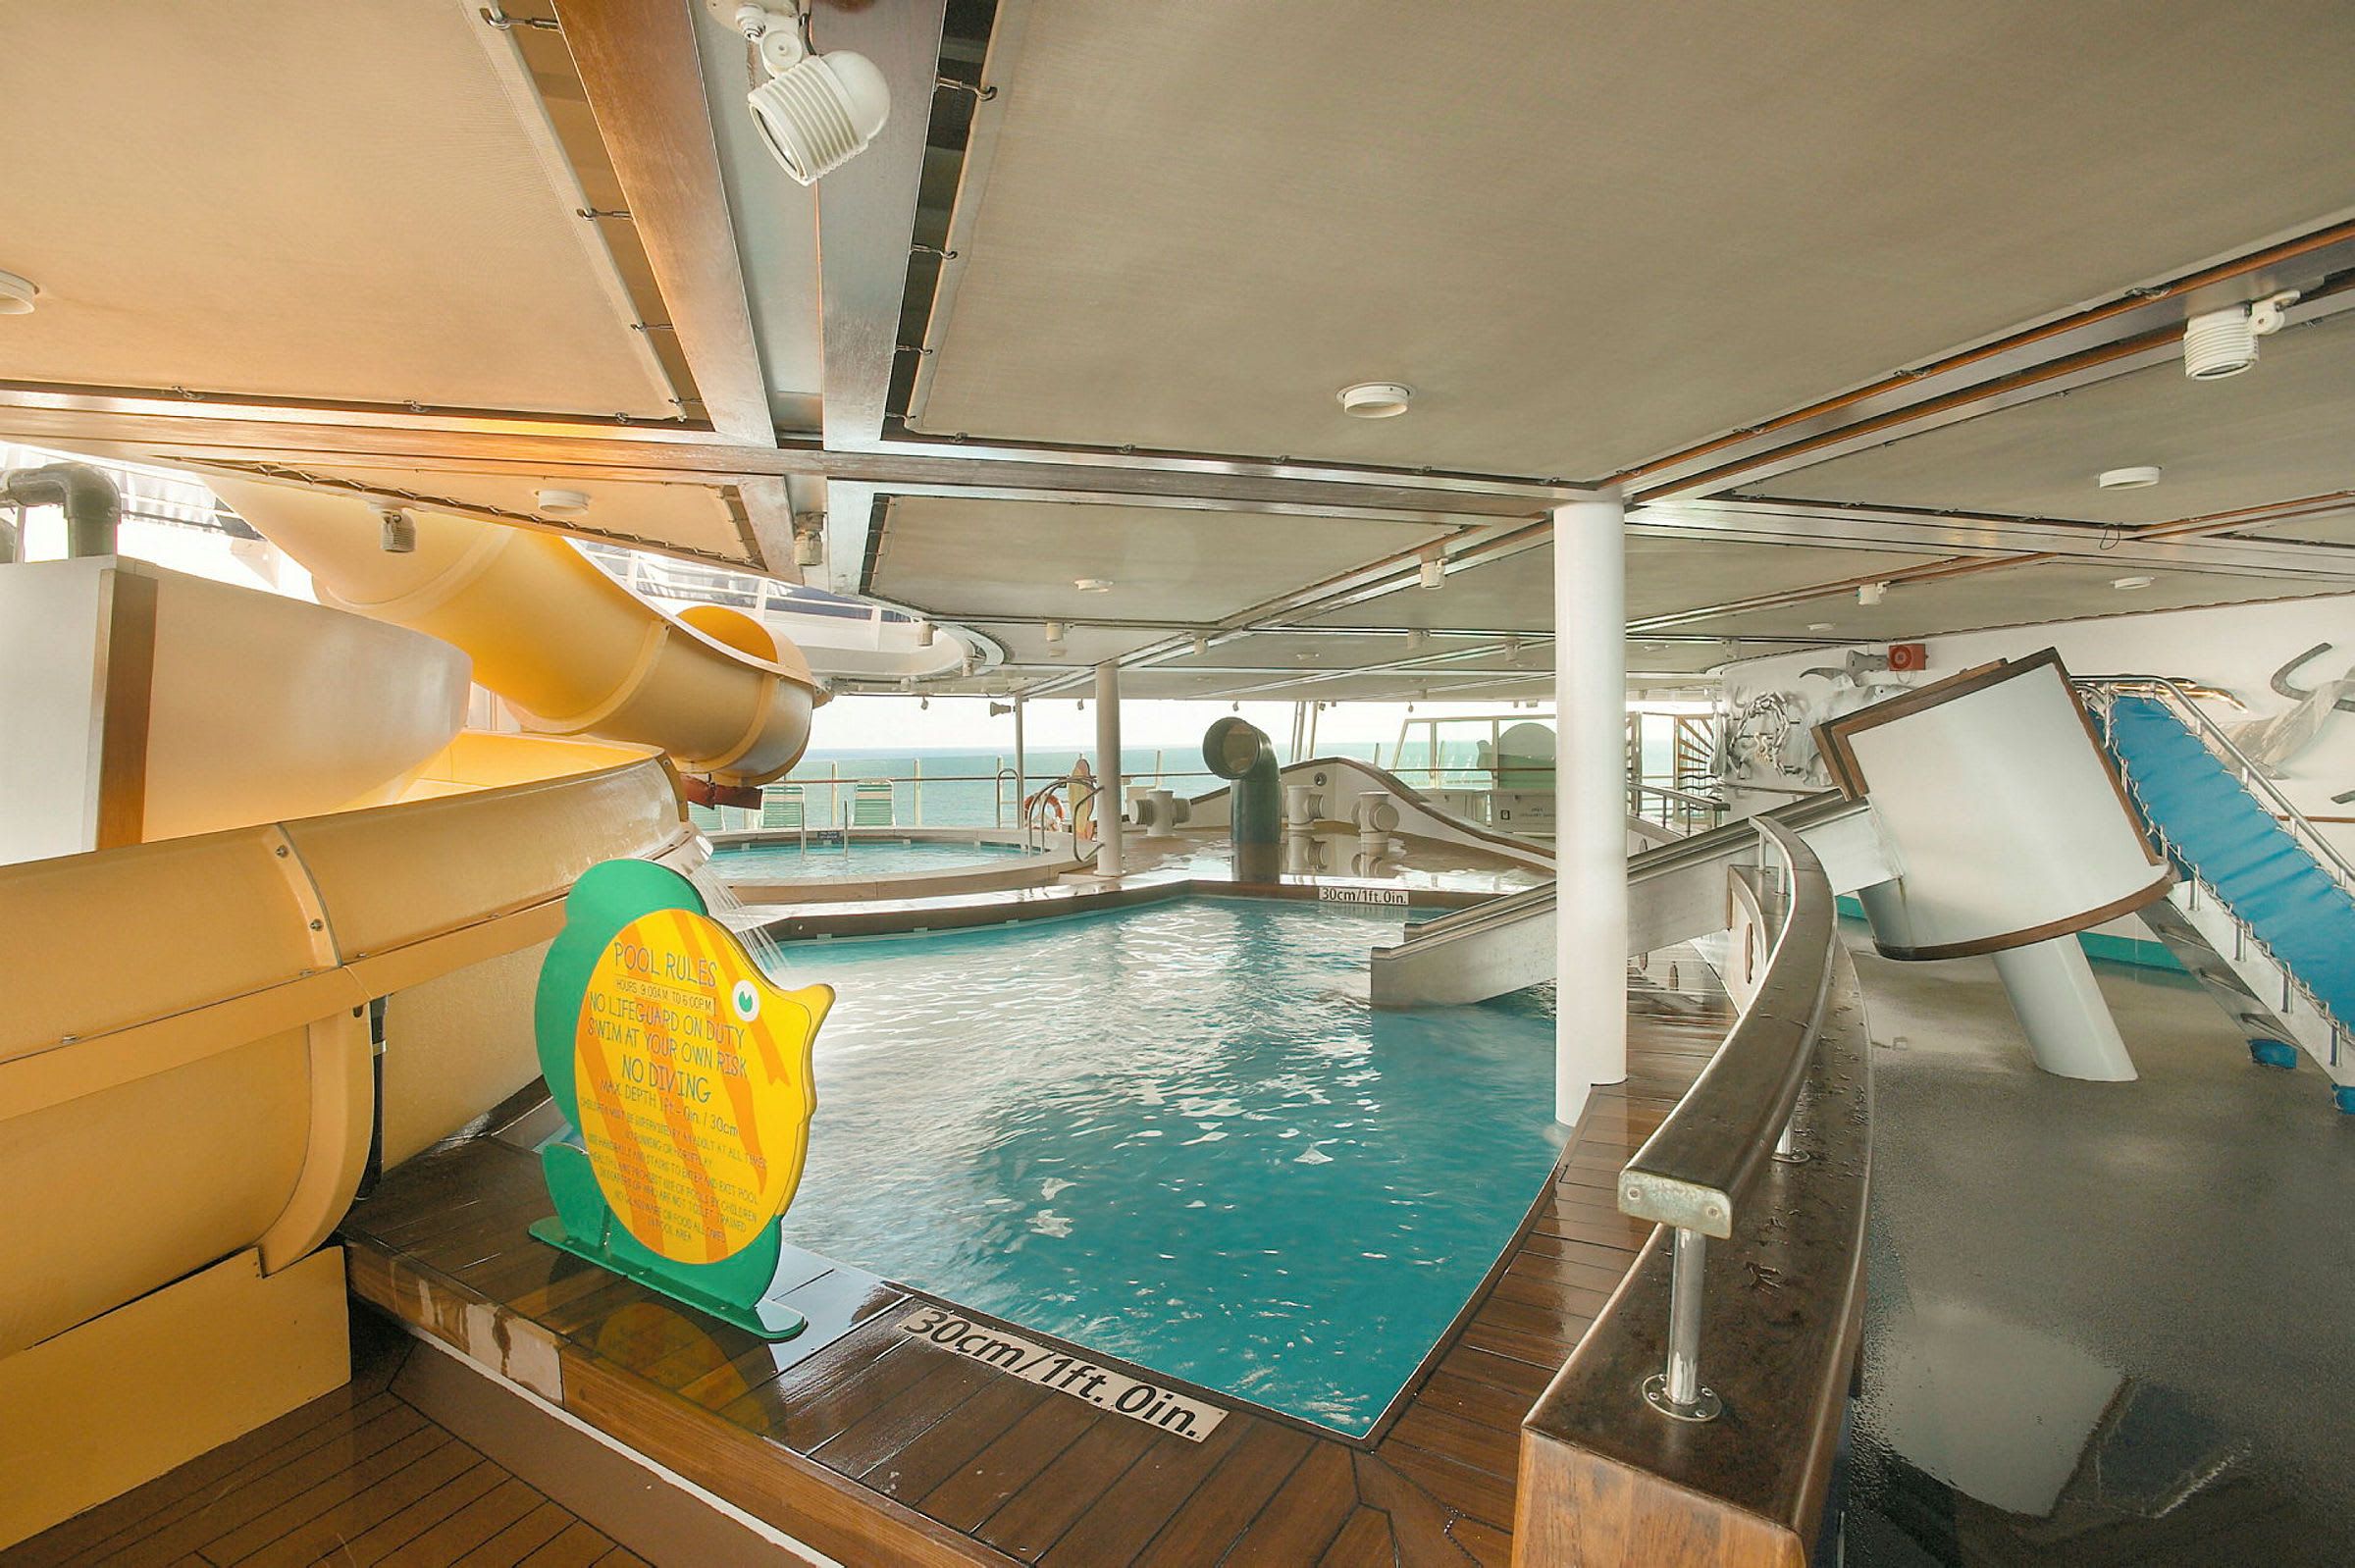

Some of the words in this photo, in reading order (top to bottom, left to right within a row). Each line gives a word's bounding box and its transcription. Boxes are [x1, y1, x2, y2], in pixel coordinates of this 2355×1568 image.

[613, 941, 660, 975] POOL
[665, 952, 717, 988] RULES
[589, 991, 605, 1014] NO
[608, 998, 680, 1031] LIFEGUARD
[683, 1015, 704, 1040] ON
[706, 1017, 745, 1049] DUTY
[589, 1017, 622, 1043] SWIM
[624, 1026, 640, 1048] AT
[644, 1032, 678, 1061] YOUR
[681, 1042, 712, 1070] OWN
[716, 1049, 748, 1079] RISK
[621, 1054, 644, 1086] NO
[648, 1063, 711, 1104] DIVING
[624, 1084, 656, 1108] DEPTH
[709, 1113, 739, 1136] 30cm
